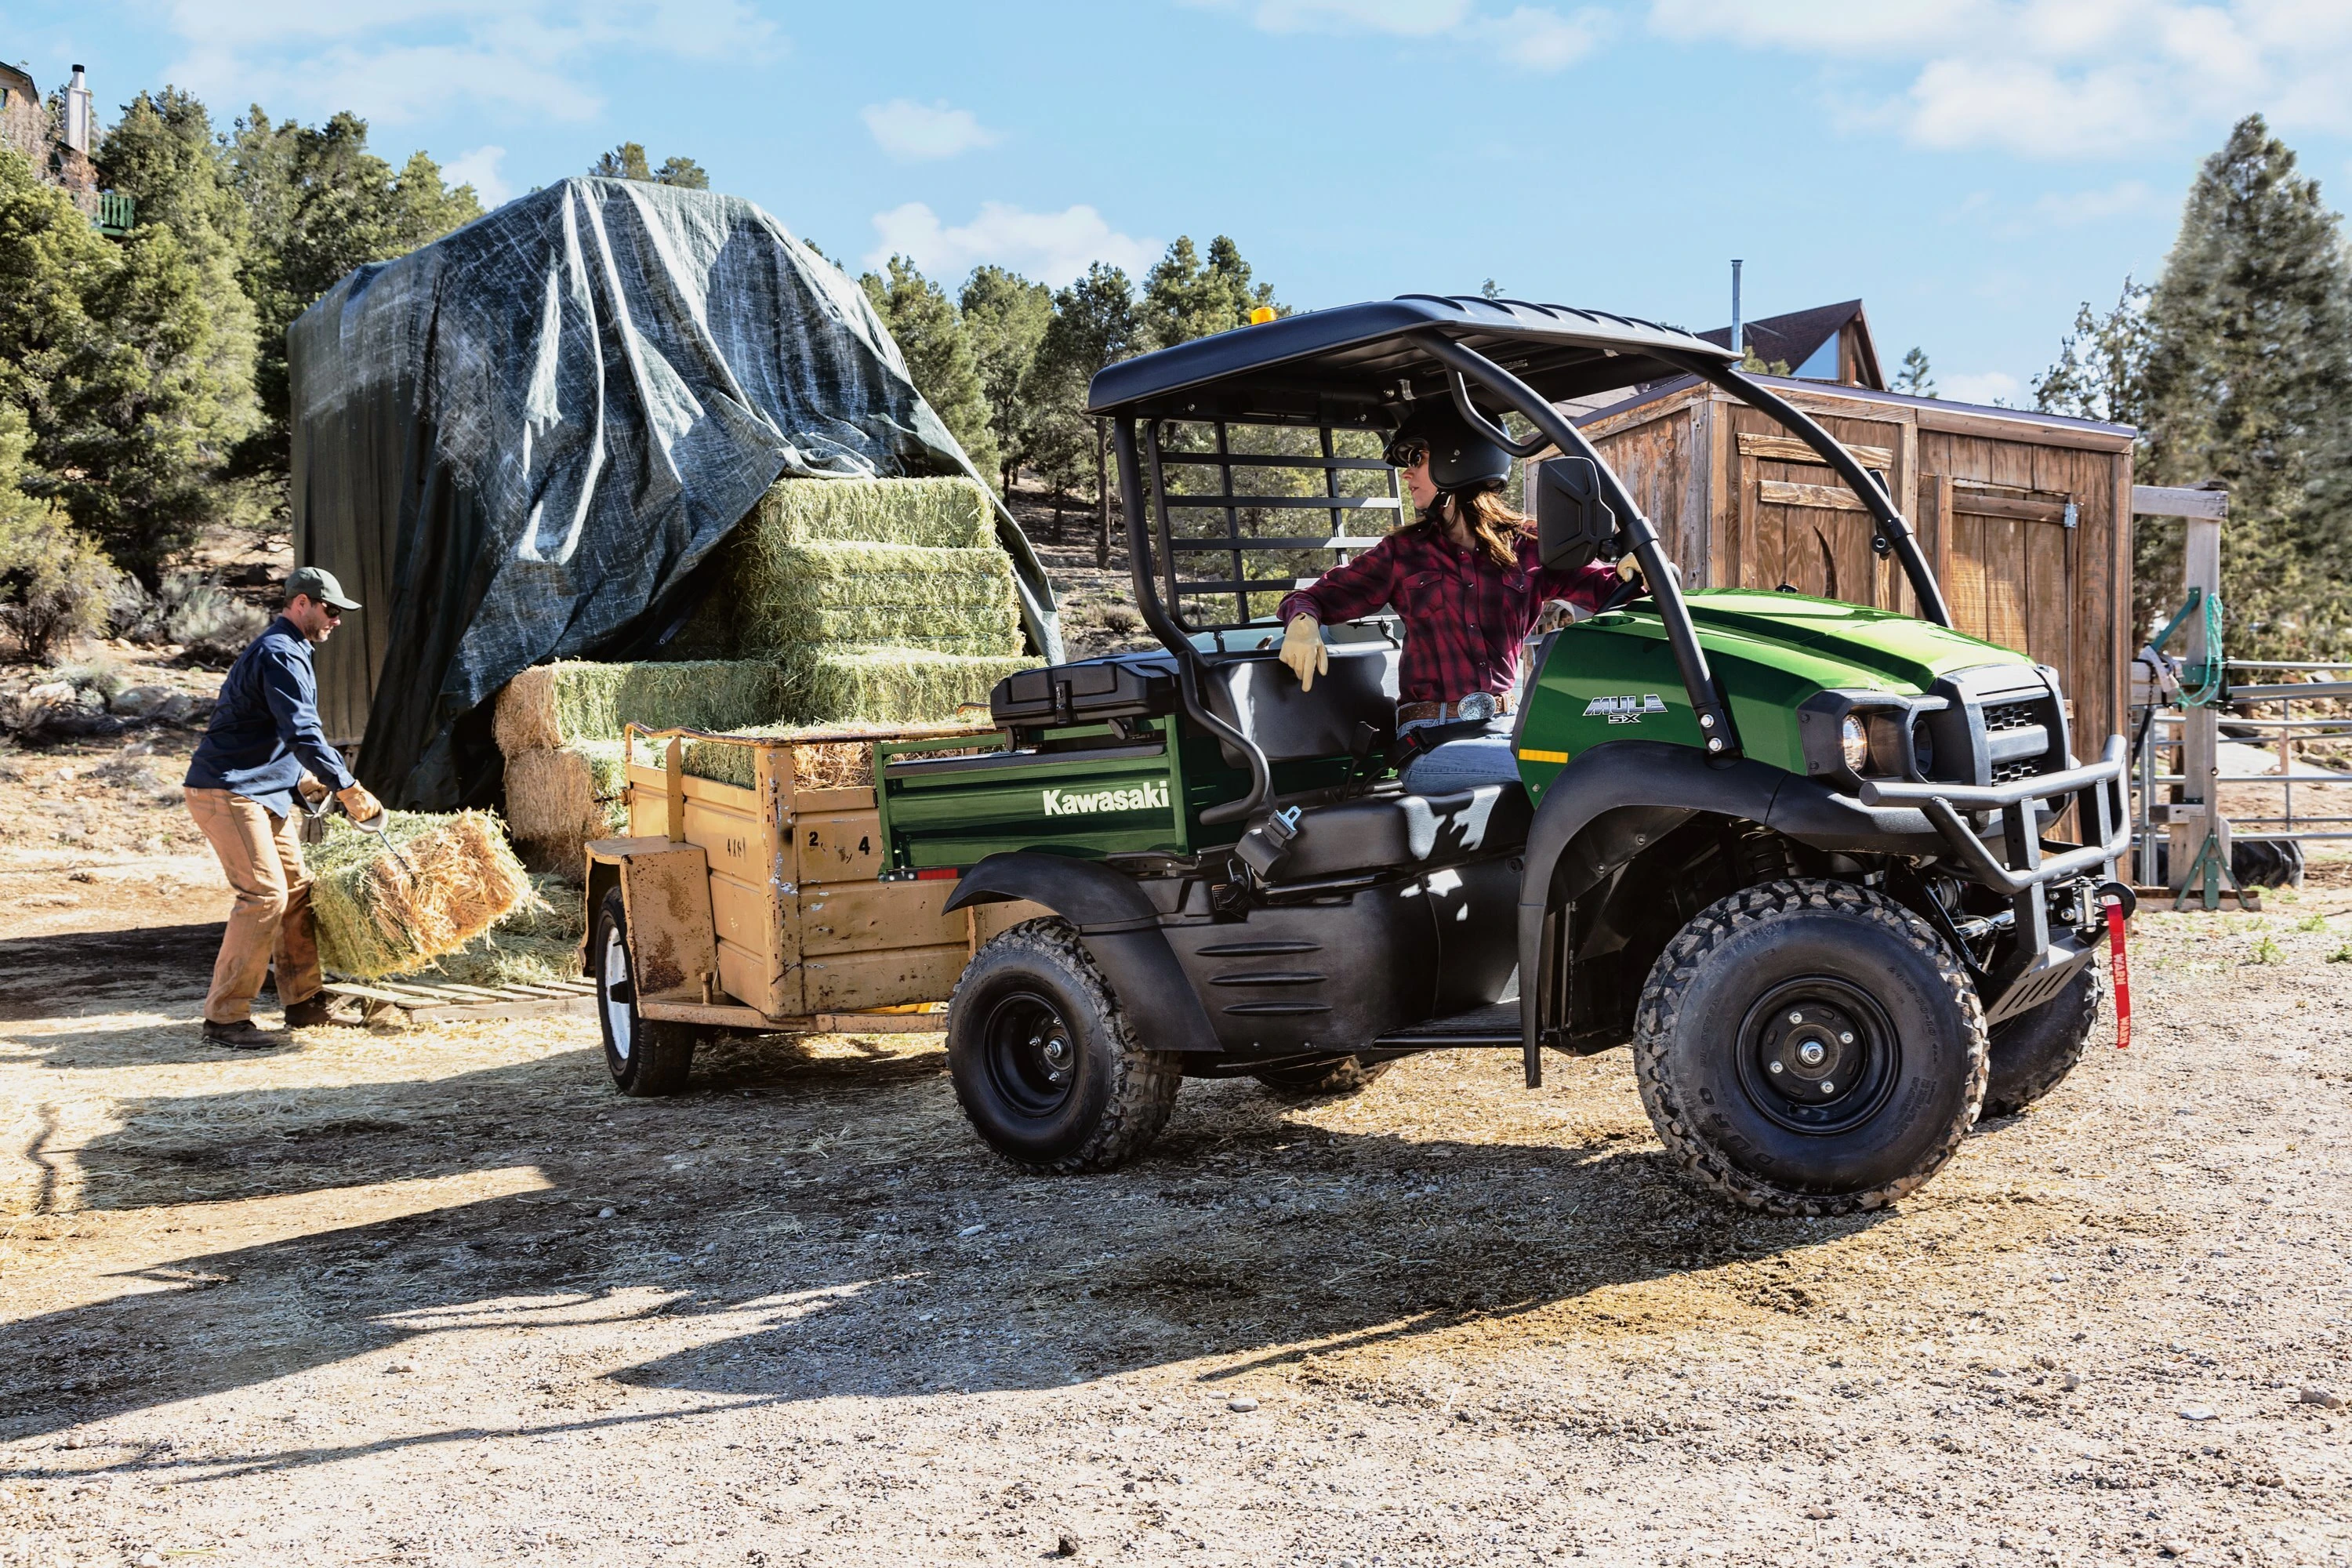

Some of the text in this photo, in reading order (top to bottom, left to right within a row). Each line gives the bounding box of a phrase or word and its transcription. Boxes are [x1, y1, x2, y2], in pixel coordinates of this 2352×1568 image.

[1582, 694, 1668, 717] MULE
[1608, 713, 1642, 724] SX
[1042, 780, 1170, 816] Kawasaki
[808, 831, 871, 855] 2 4
[2113, 953, 2127, 985] WARN
[2119, 1015, 2131, 1045] WARN
[1698, 1087, 1776, 1166] DURO
